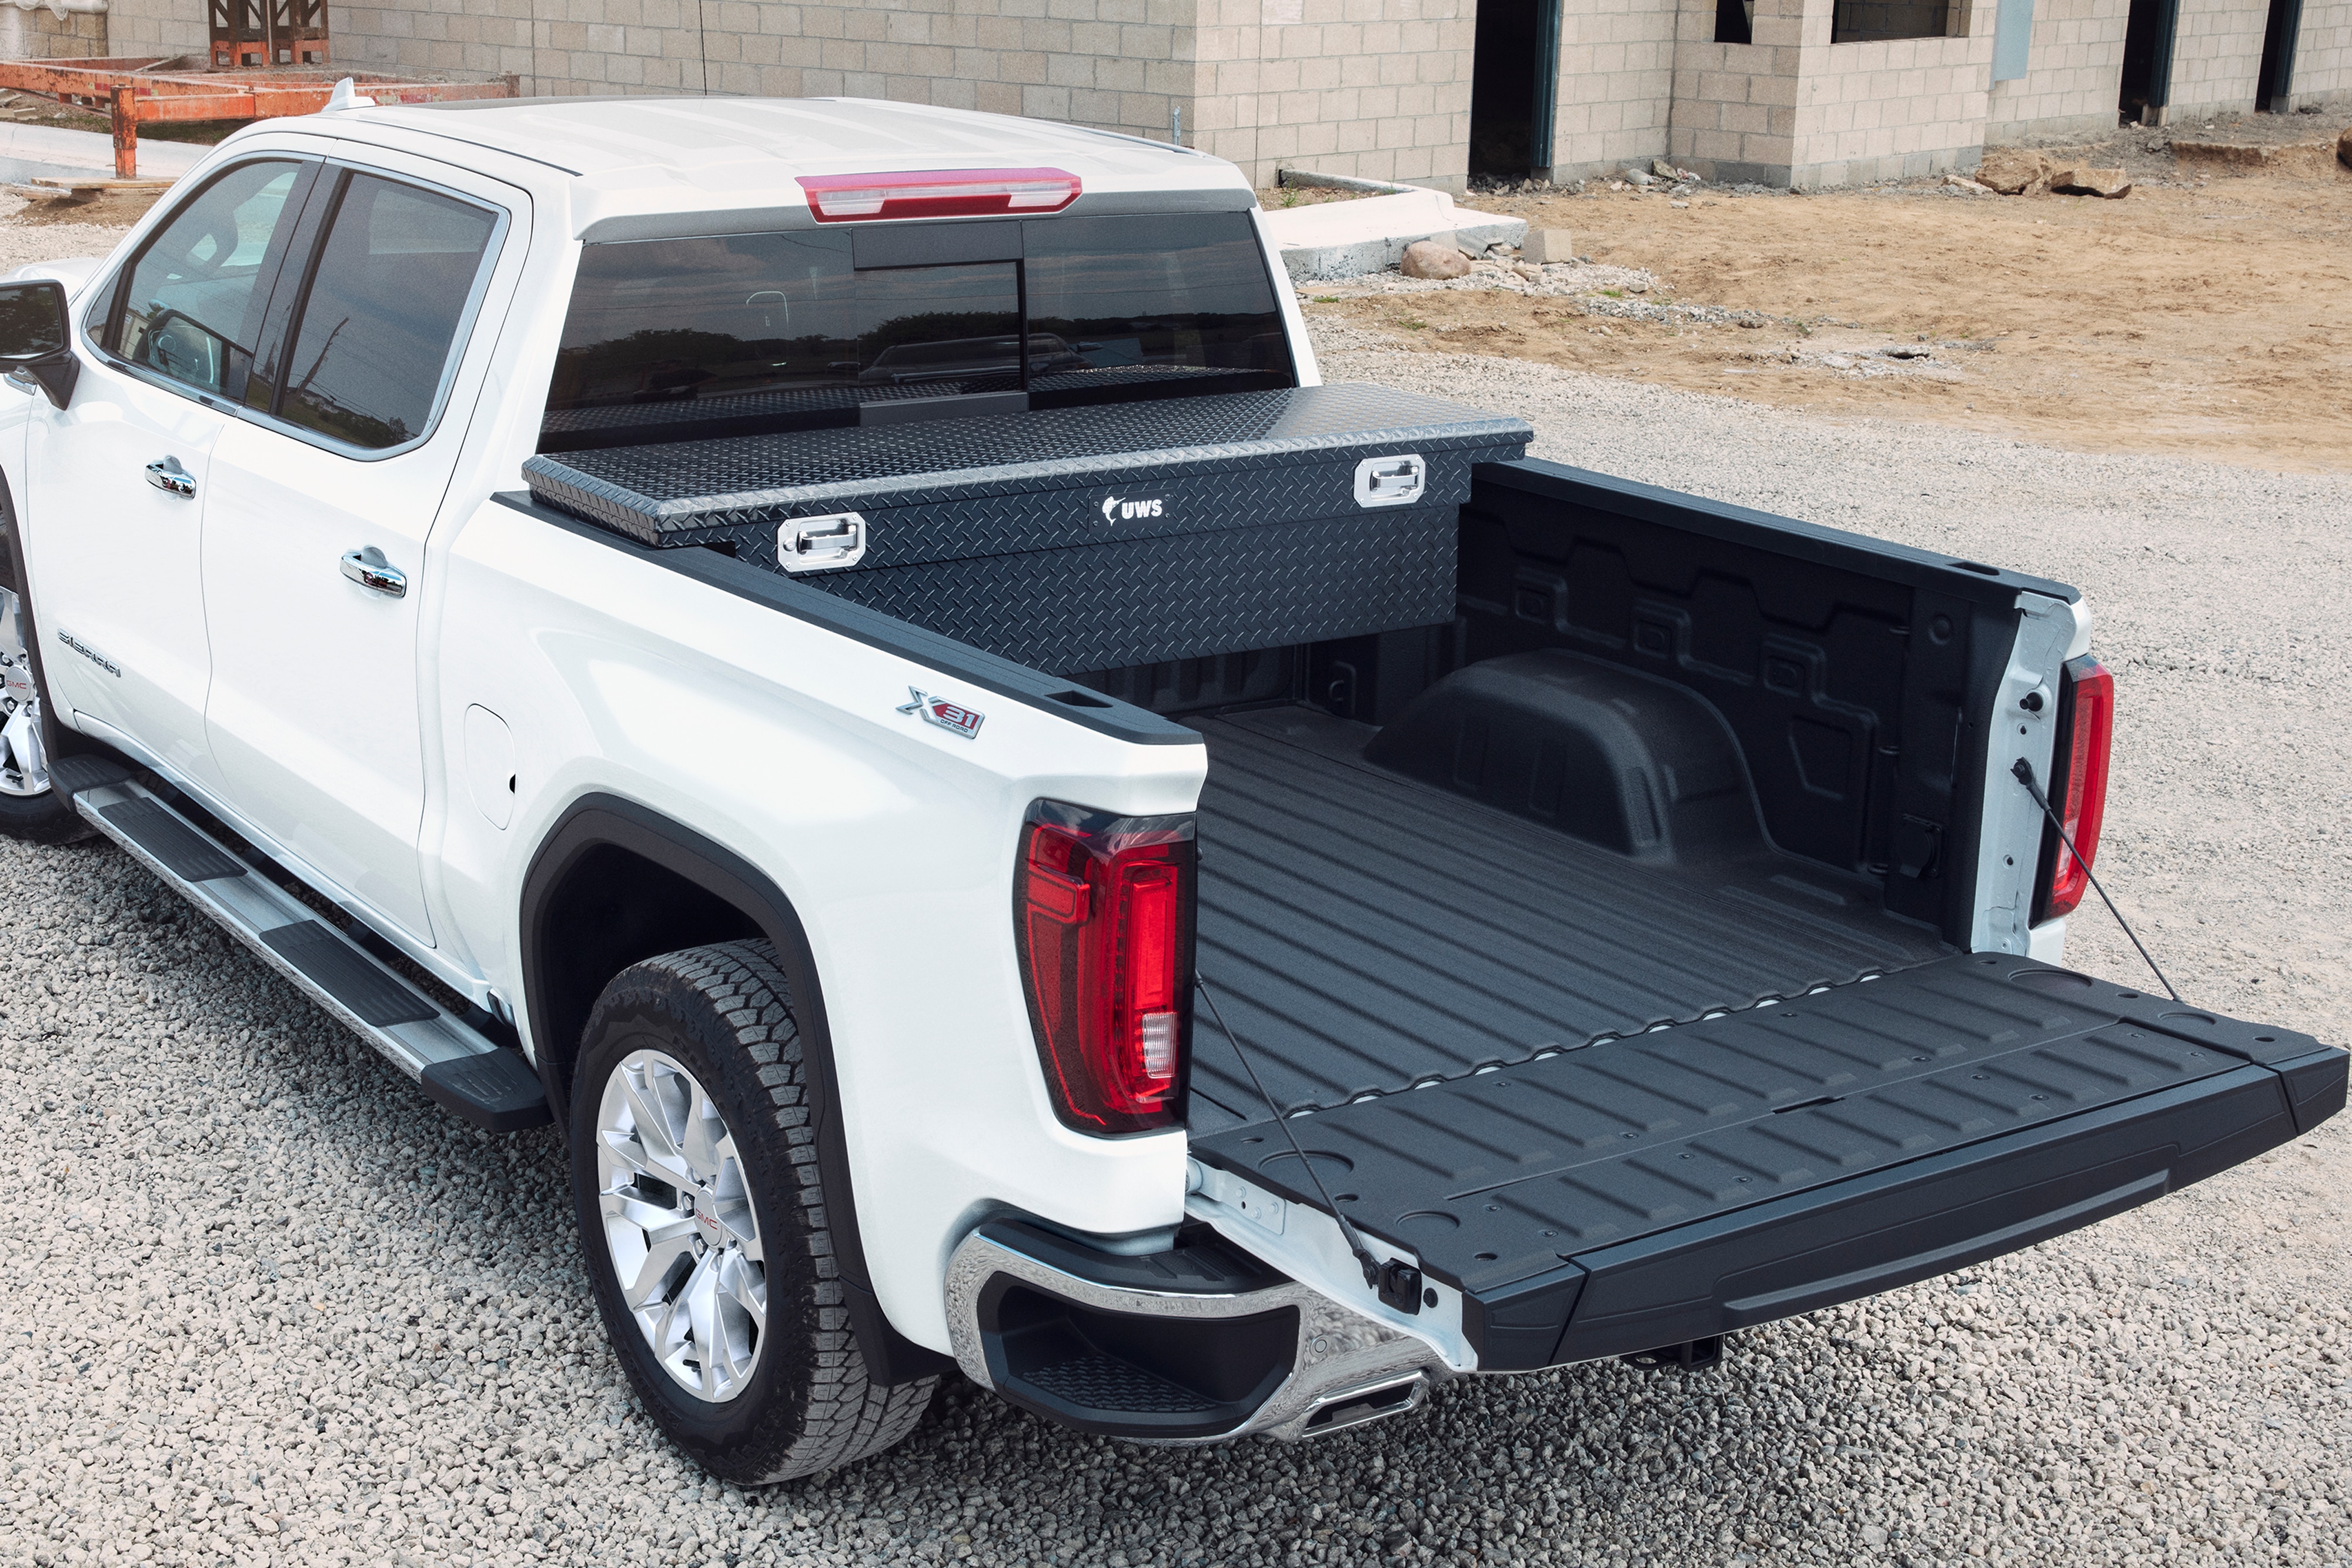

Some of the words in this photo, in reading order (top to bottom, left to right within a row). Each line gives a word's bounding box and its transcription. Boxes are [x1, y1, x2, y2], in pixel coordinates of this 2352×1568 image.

[1121, 499, 1163, 520] UWS
[57, 628, 122, 678] SIERRA
[6, 680, 27, 690] GMC
[895, 685, 978, 729] X31
[952, 723, 968, 733] ROAD
[695, 1208, 718, 1231] GMC
